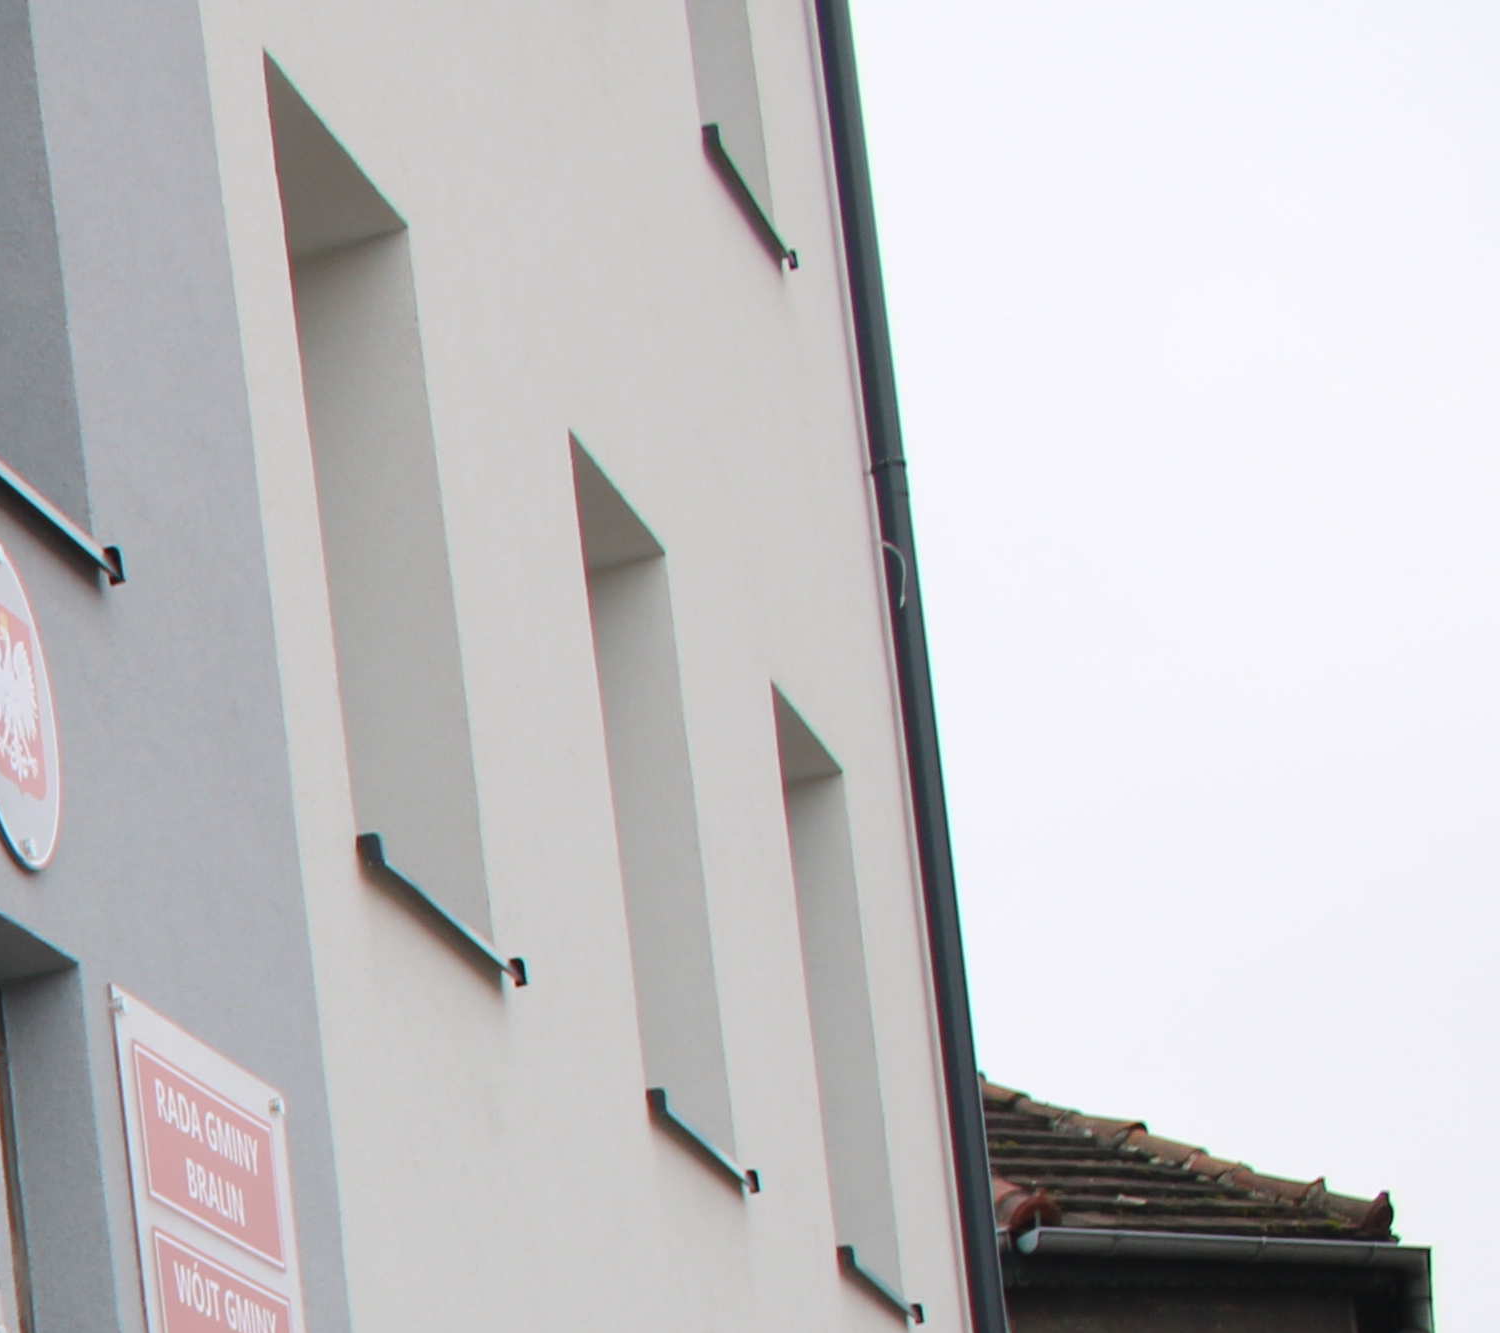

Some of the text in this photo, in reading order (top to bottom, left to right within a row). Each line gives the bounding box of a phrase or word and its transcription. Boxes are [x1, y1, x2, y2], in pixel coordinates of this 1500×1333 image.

[154, 1077, 258, 1176] RADA GMINY
[185, 1157, 245, 1227] BRALIN
[173, 1261, 220, 1322] WÓJT
